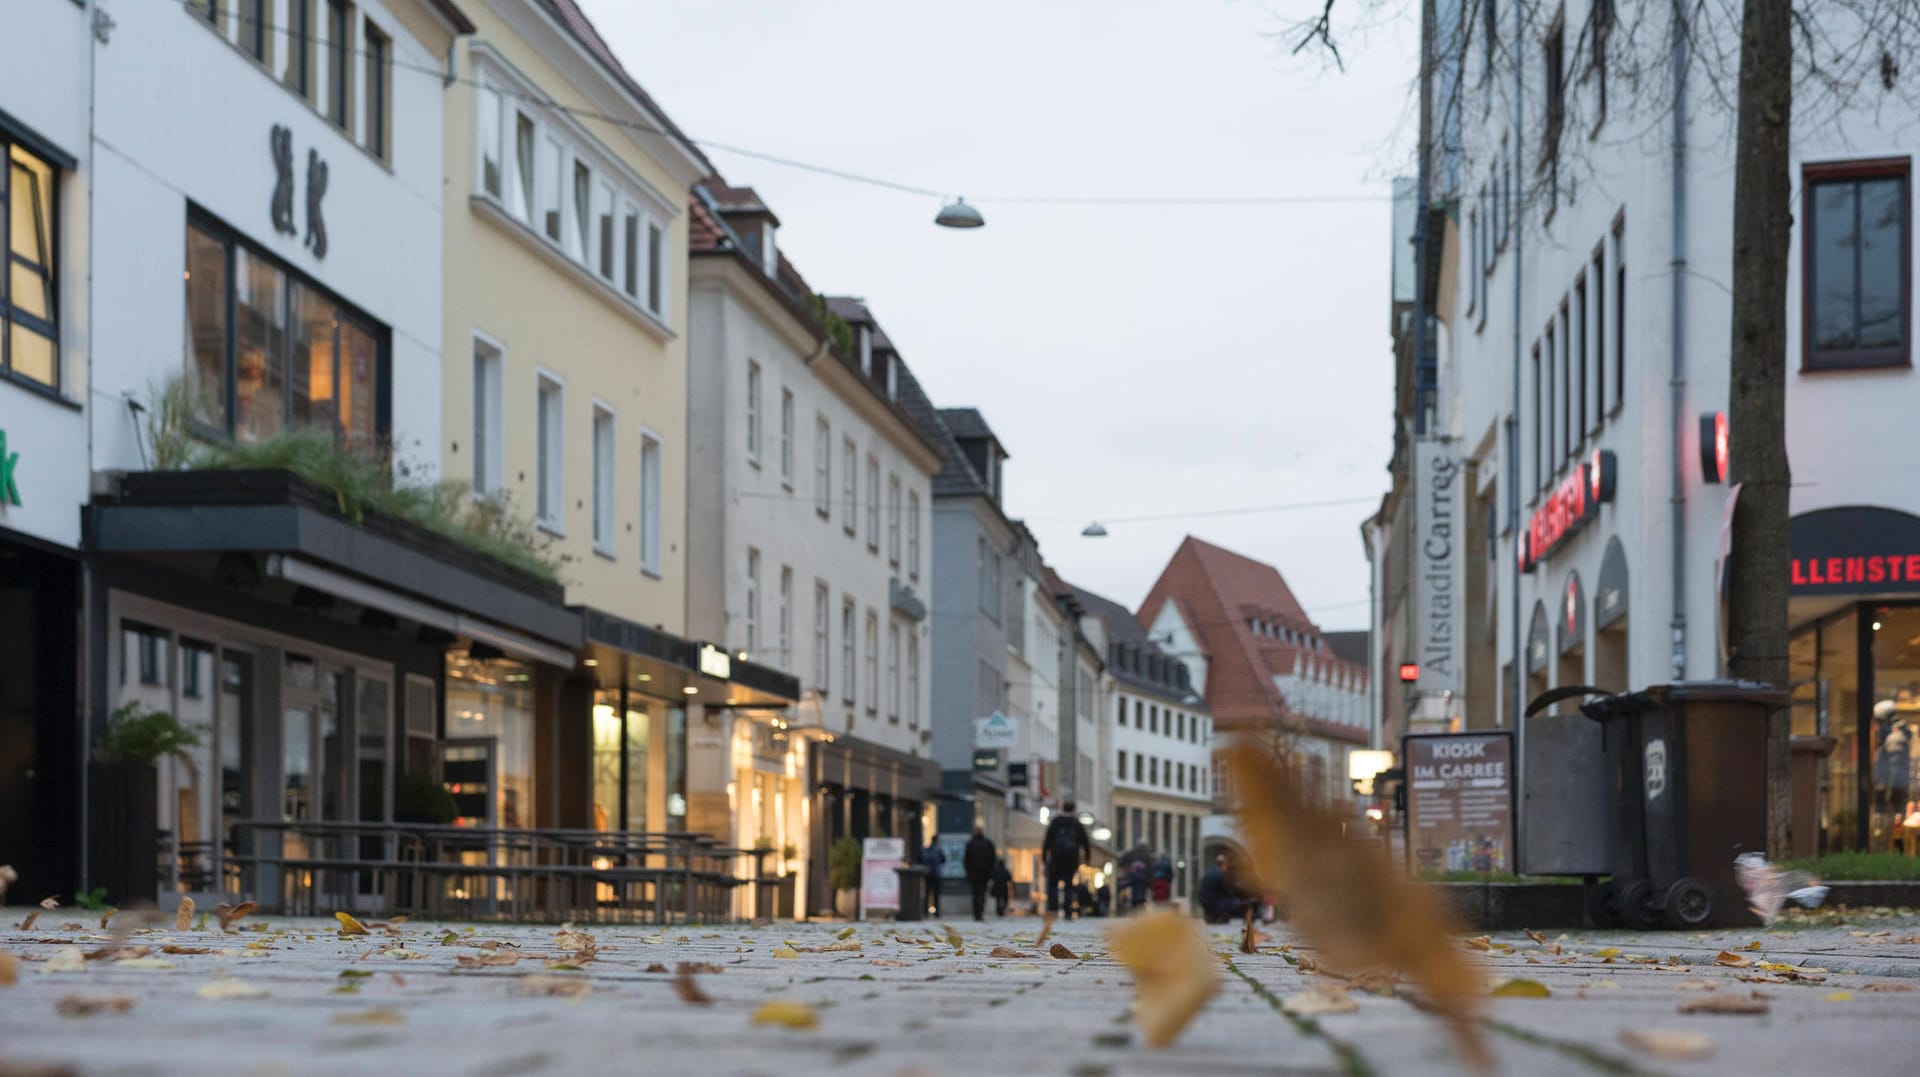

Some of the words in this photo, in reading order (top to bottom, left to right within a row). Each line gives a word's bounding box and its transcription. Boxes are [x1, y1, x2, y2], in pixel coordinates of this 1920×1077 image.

[1424, 455, 1459, 677] AltstadtCarree
[1431, 743, 1486, 759] KIOSK
[1413, 765, 1435, 778] IM
[1439, 762, 1505, 778] CARREE
